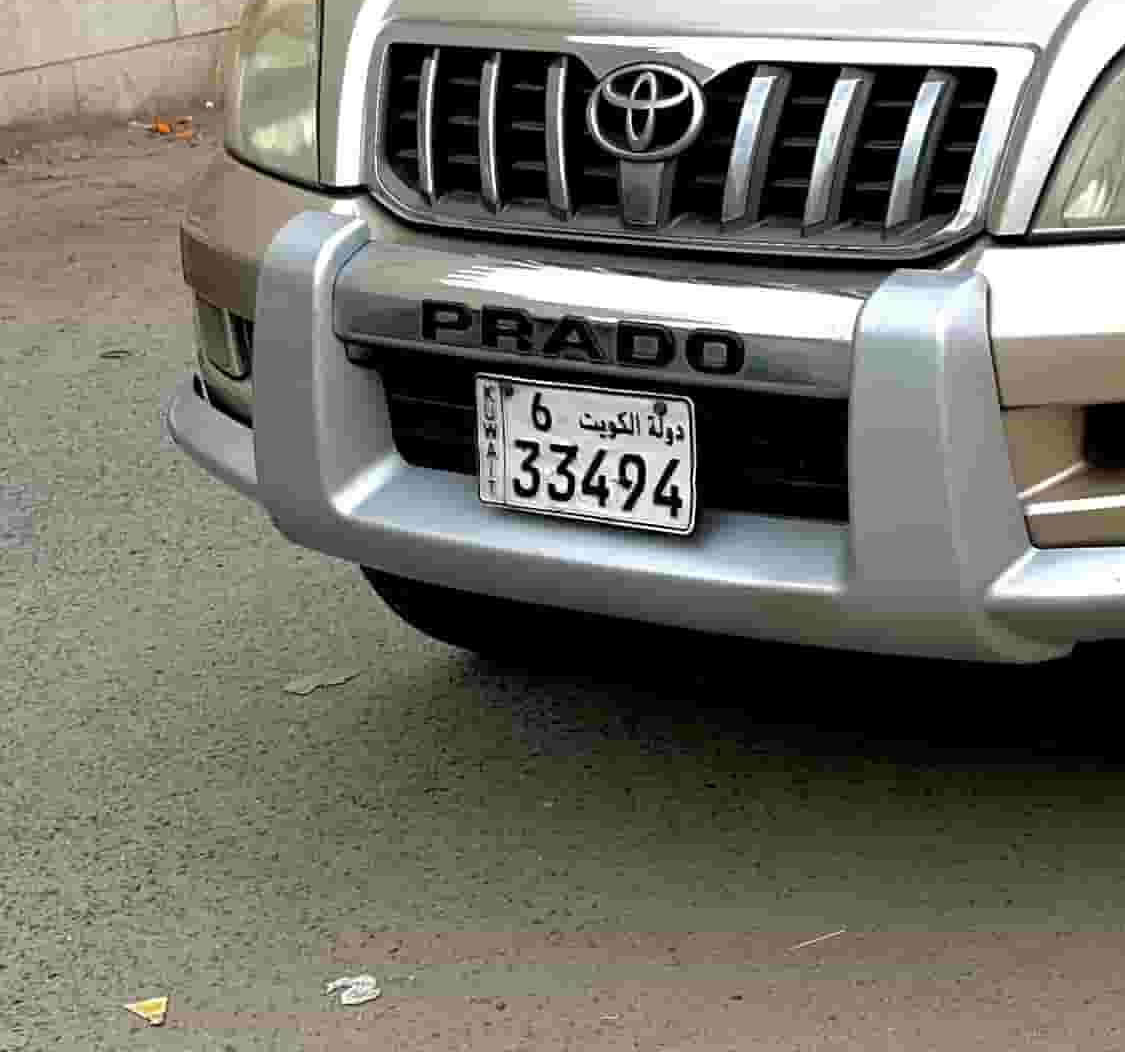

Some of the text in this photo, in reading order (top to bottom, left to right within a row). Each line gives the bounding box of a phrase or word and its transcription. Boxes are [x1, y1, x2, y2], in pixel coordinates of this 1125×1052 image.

[420, 299, 745, 375] PRADO
[483, 384, 498, 494] KUWAIT
[531, 392, 552, 432] 6
[579, 411, 685, 446] دولة الكويت
[512, 439, 683, 517] 33494
